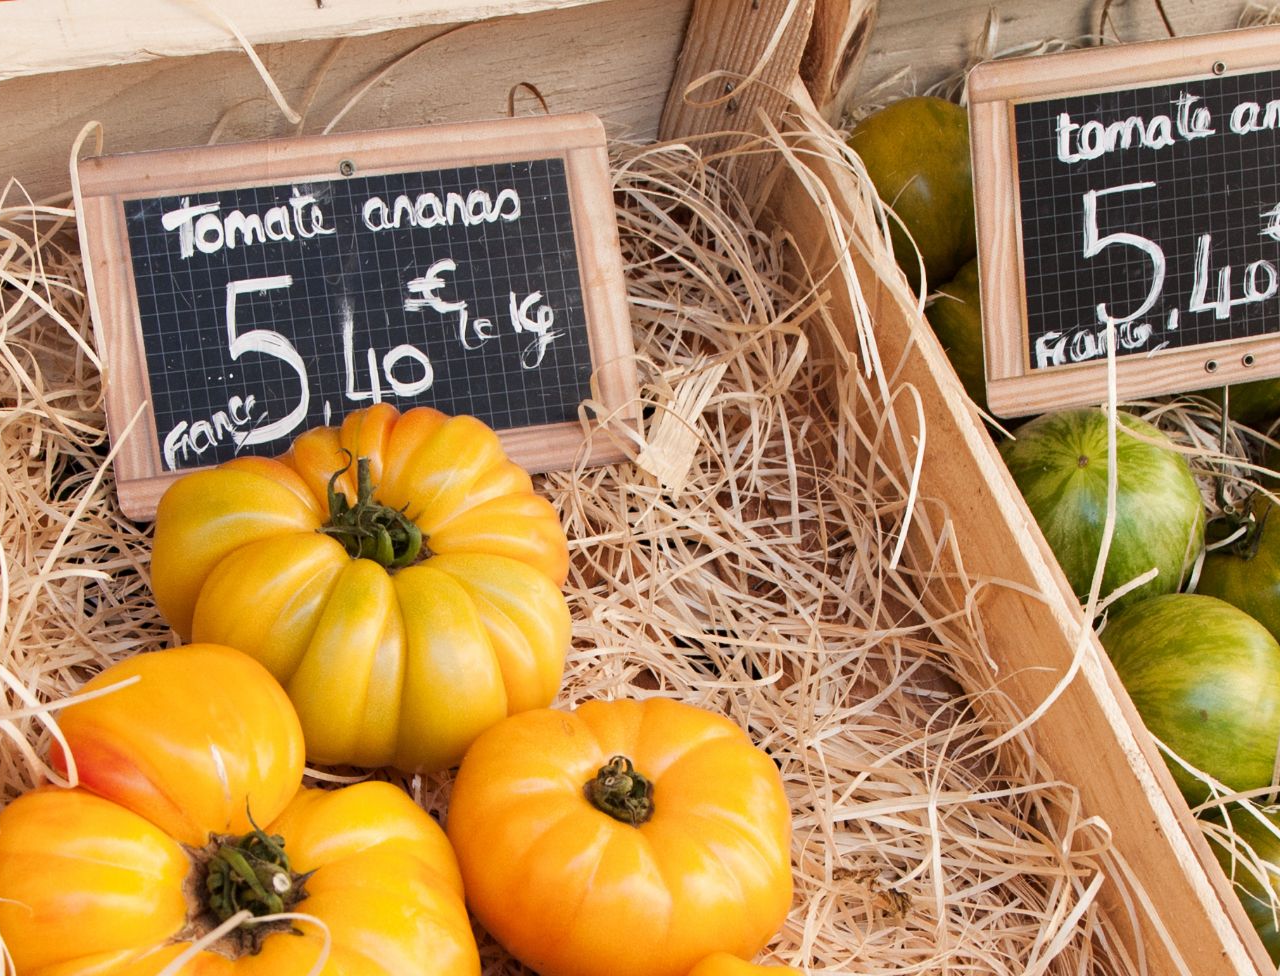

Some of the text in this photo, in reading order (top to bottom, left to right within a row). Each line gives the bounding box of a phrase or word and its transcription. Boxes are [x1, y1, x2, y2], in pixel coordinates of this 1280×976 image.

[1056, 92, 1216, 163] tomate
[161, 187, 521, 259] Tomate ananas
